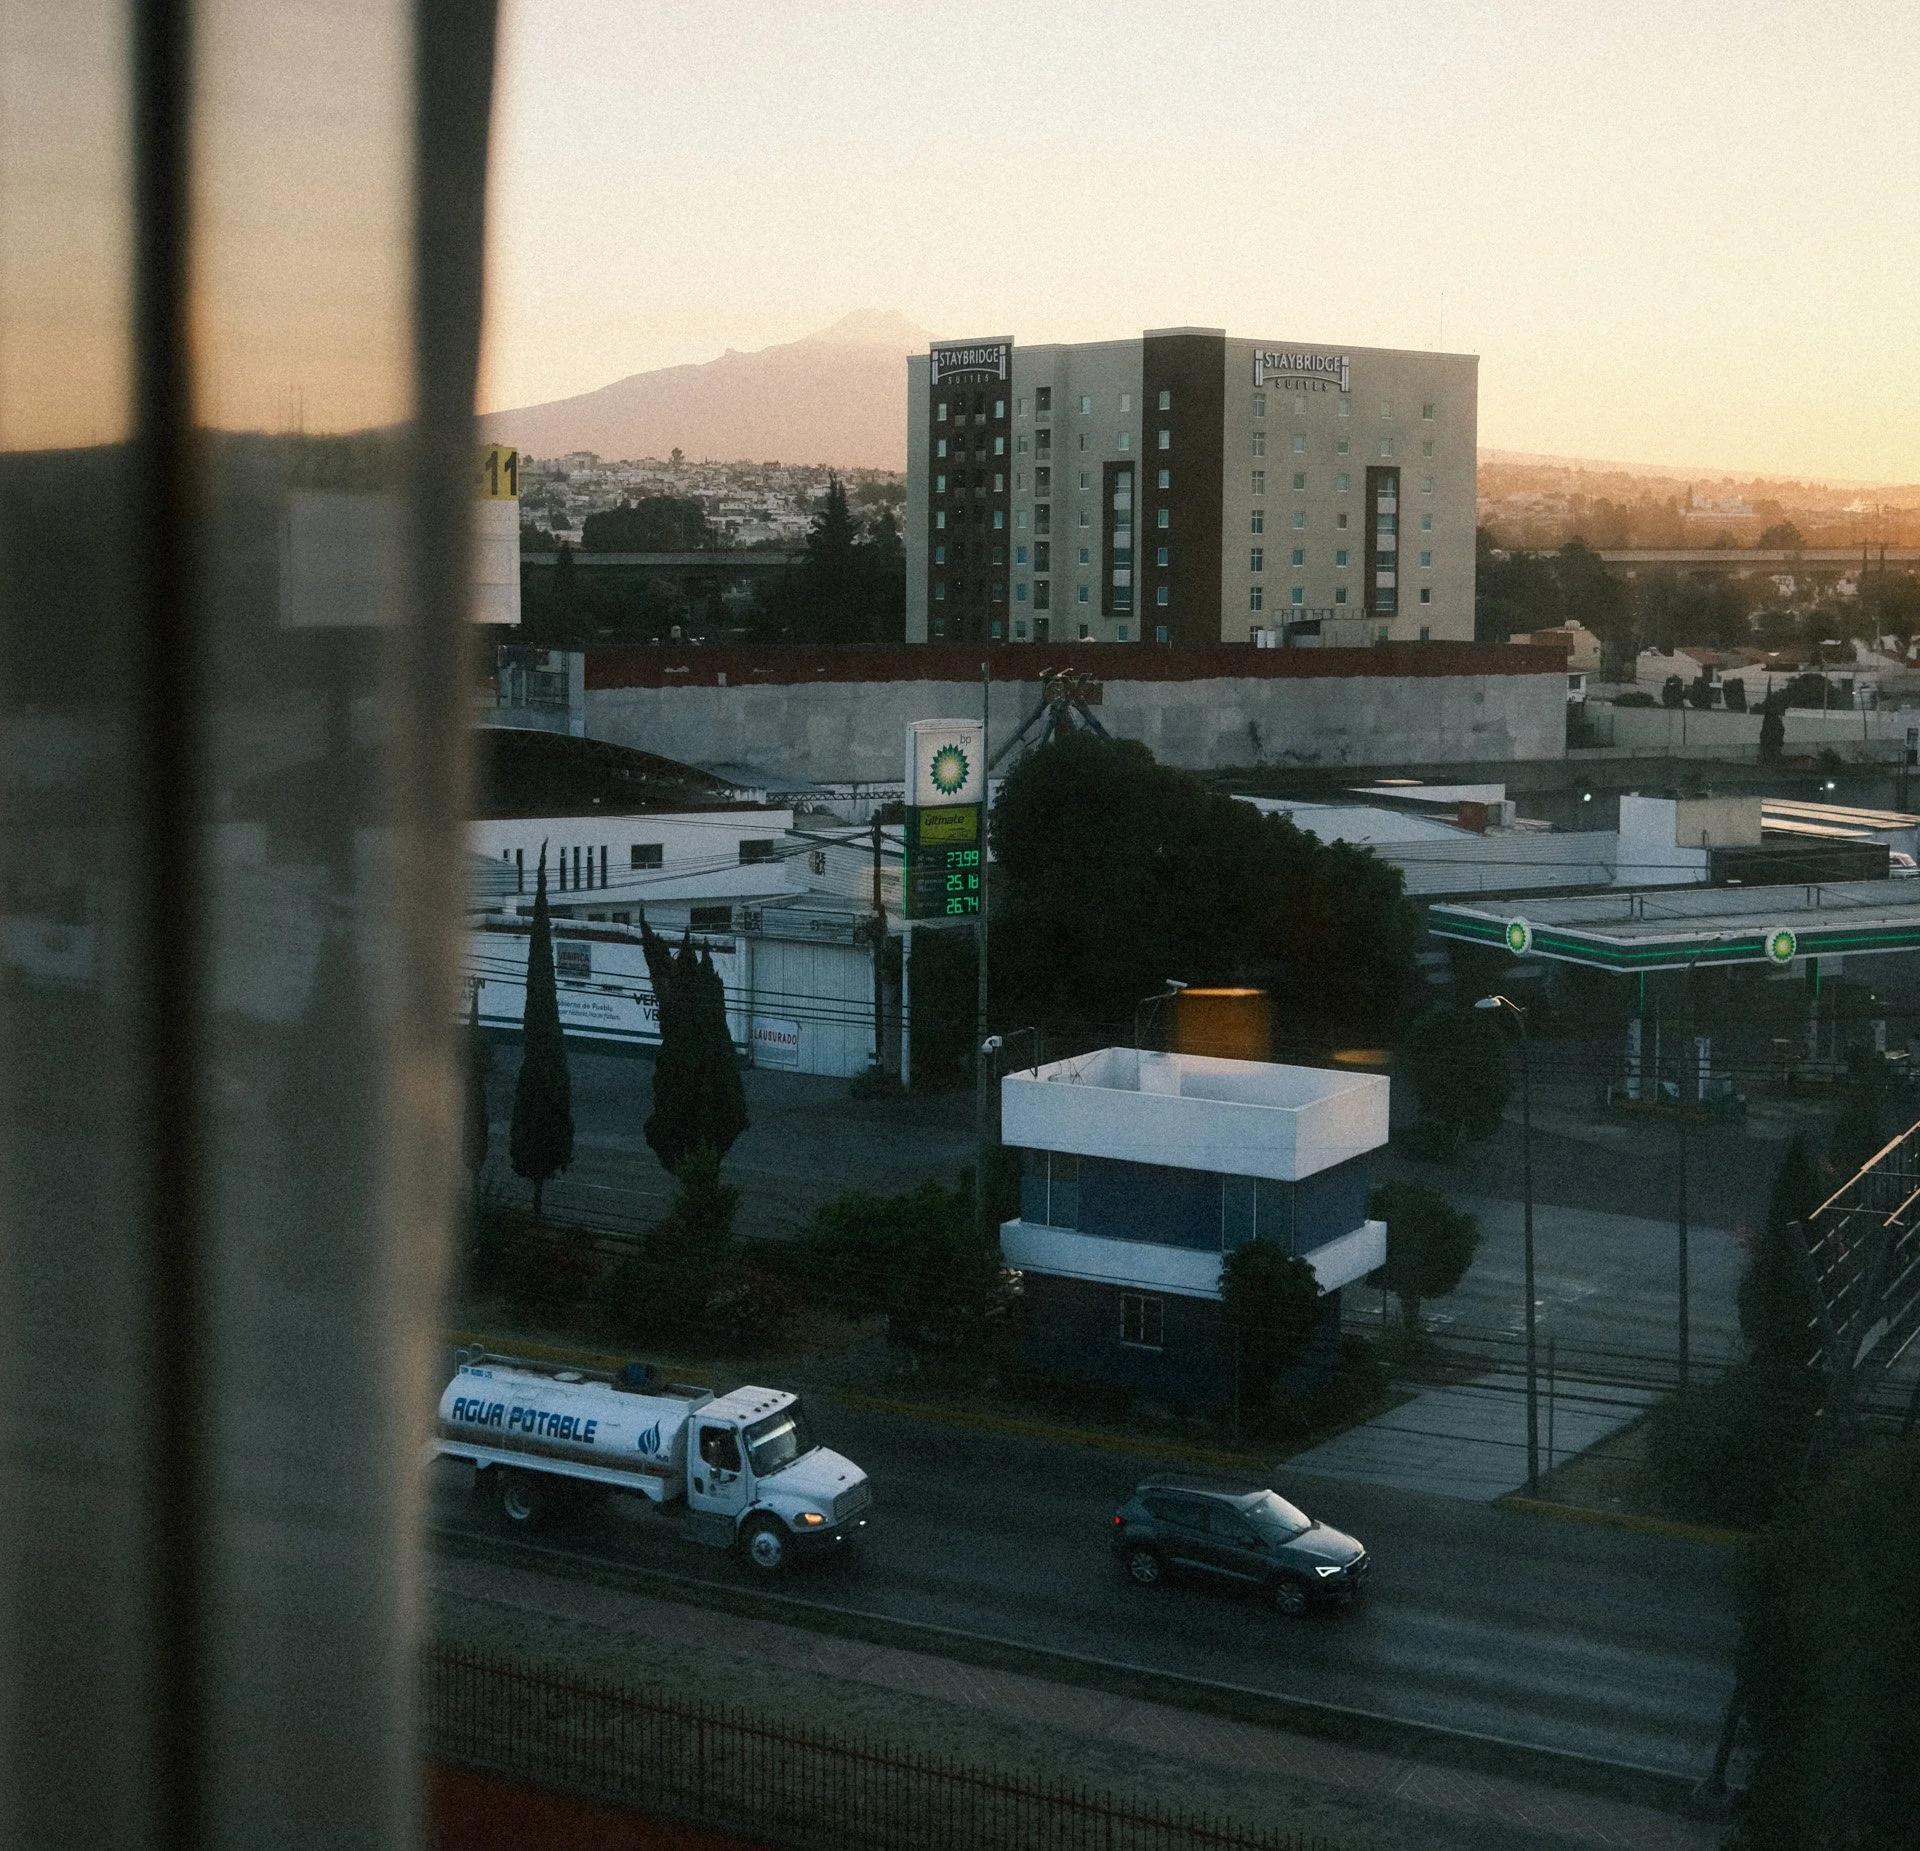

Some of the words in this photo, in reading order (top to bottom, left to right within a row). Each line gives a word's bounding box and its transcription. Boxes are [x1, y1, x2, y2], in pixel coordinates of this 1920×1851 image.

[938, 348, 999, 367] STAYBRIDGE
[1264, 351, 1341, 372] STAYBRIDGE
[947, 374, 990, 385] SUITES
[1275, 378, 1329, 391] SUITES
[960, 734, 972, 746] bp
[925, 814, 965, 826] ultimate
[946, 850, 979, 868] 23.99
[946, 896, 979, 915] 26.74
[557, 1000, 581, 1009] obierno
[452, 1397, 504, 1425] AGUA
[508, 1405, 598, 1444] POTABLE
